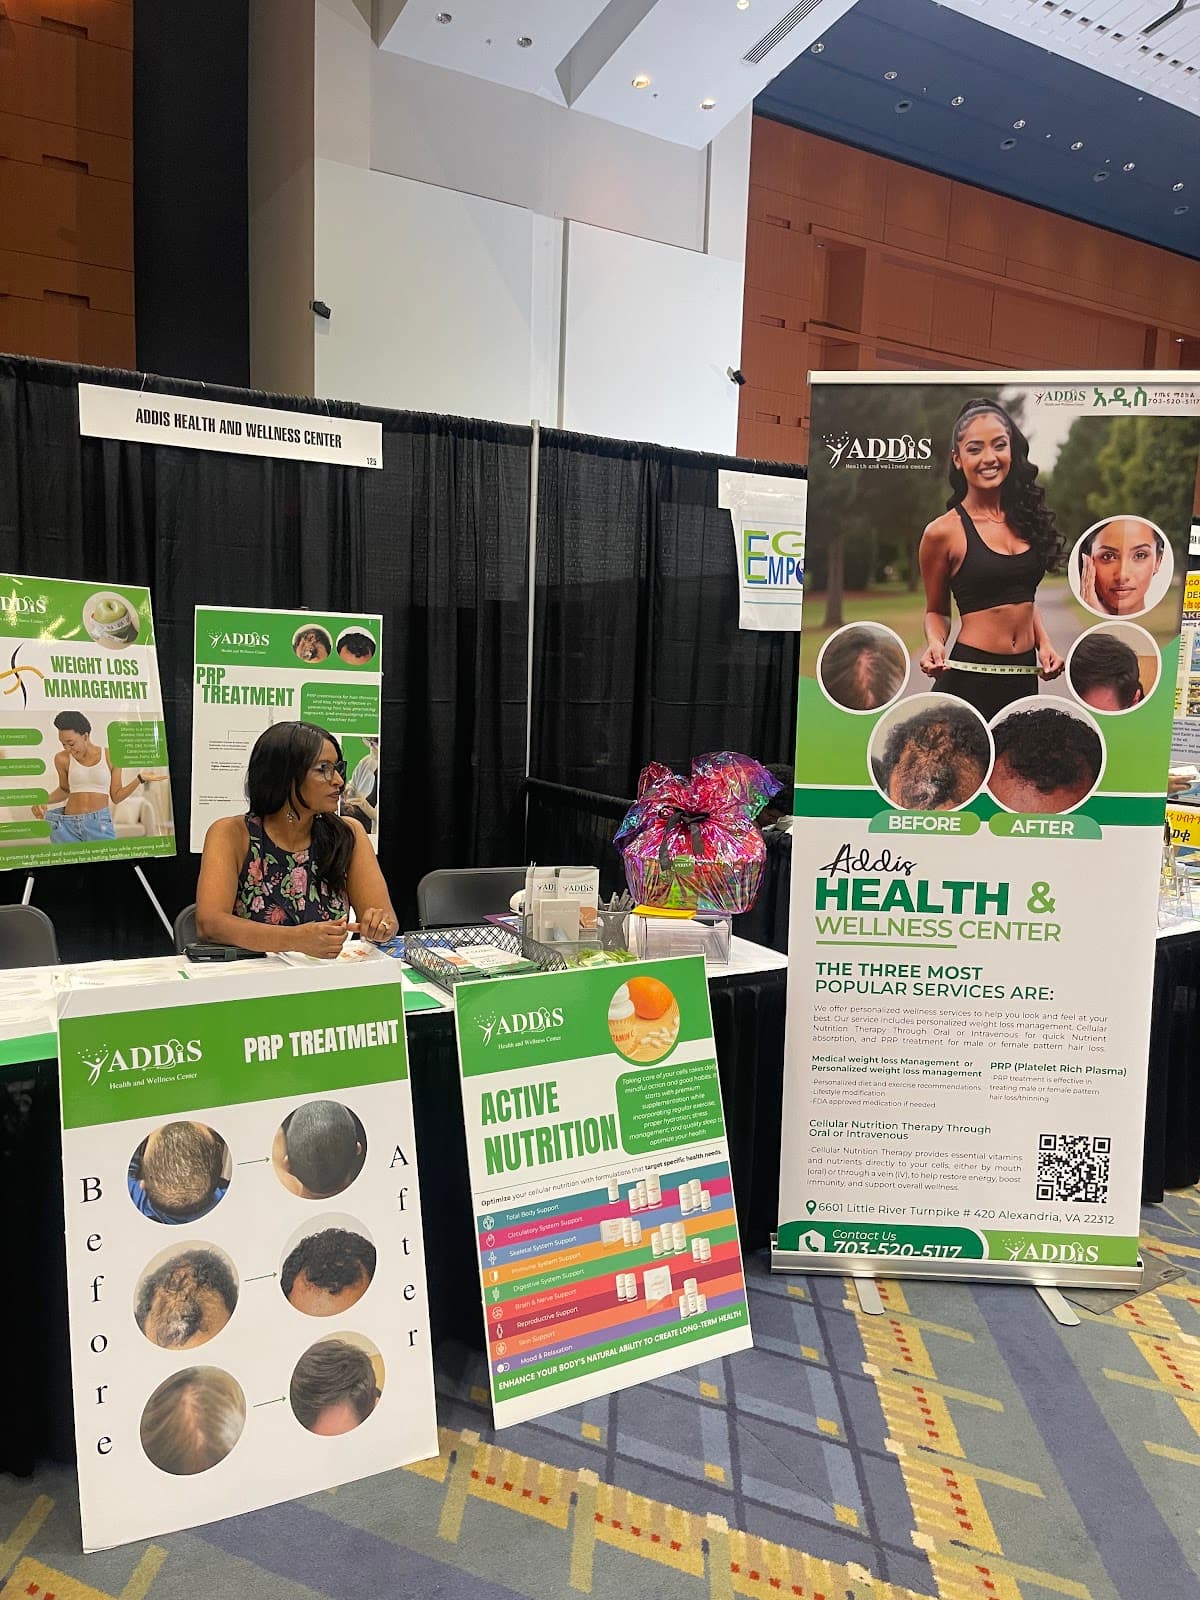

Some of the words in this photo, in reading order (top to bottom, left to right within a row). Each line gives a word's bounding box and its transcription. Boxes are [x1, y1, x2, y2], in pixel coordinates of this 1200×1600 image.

[1093, 386, 1147, 408] አዲስ
[136, 408, 169, 426] ADDIS
[174, 413, 215, 432] HEALTH
[219, 419, 241, 435] AND
[245, 422, 300, 443] WELLNESS
[304, 430, 341, 448] CENTER
[50, 656, 102, 673] WEIGHT
[106, 658, 139, 676] LOSS
[196, 667, 225, 684] PRP
[44, 679, 148, 699] MANAGEMENT
[202, 684, 294, 706] TREATMENT
[888, 816, 960, 832] BEFORE
[1010, 819, 1075, 835] AFTER
[819, 844, 917, 877] Addis
[815, 878, 1009, 916] HEALTH
[1027, 881, 1056, 914] &
[815, 916, 953, 938] WELLNESS
[959, 920, 1061, 942] CENTER
[815, 962, 852, 976] THE
[858, 963, 920, 978] THREE
[927, 965, 982, 980] MOST
[816, 979, 906, 995] POPULAR
[912, 982, 1004, 998] SERVICES
[1010, 986, 1053, 1000] ARE:
[496, 1007, 564, 1034] ADDiS
[244, 1037, 283, 1064] PRP
[289, 1019, 399, 1057] TREATMENT
[107, 1038, 202, 1071] ADDiS
[847, 1056, 878, 1064] weight
[900, 1058, 959, 1066] Management
[869, 1066, 900, 1074] weight
[922, 1069, 982, 1077] management
[1014, 1062, 1056, 1072] (Platelet
[1059, 1064, 1082, 1073] Rich
[1085, 1066, 1126, 1077] Plasma)
[109, 1080, 131, 1089] Health
[481, 1081, 560, 1126] ACTIVE
[809, 1119, 848, 1131] Cellular
[851, 1120, 898, 1129] Nutrition
[901, 1122, 943, 1133] Therapy
[948, 1124, 990, 1135] Through
[809, 1128, 829, 1136] Oral
[846, 1130, 908, 1139] Intravenous
[484, 1114, 618, 1175] NUTRITION
[481, 1195, 510, 1206] Optimize
[512, 1191, 529, 1201] your
[528, 1186, 551, 1196] cellular
[552, 1180, 581, 1191] nutrition
[580, 1176, 594, 1184] with
[595, 1169, 631, 1181] formulations
[631, 1165, 645, 1173] that
[645, 1162, 664, 1170] target
[663, 1157, 684, 1167] specific
[536, 1204, 559, 1214] Support
[818, 1202, 842, 1212] 6601
[847, 1203, 874, 1213] Little
[878, 1204, 906, 1214] River
[909, 1206, 959, 1217] Turnpike
[973, 1209, 995, 1218] 420
[998, 1210, 1061, 1222] Alexandria,
[1065, 1213, 1080, 1222] VA
[1083, 1214, 1114, 1224] 22312
[507, 1227, 538, 1238] Circulatory
[538, 1222, 559, 1231] System
[560, 1216, 583, 1226] Support
[832, 1229, 879, 1240] Contact
[882, 1231, 896, 1241] Us
[509, 1246, 531, 1256] Skeletal
[532, 1242, 553, 1251] System
[554, 1235, 576, 1245] Support
[833, 1241, 963, 1258] 703-520-5117
[513, 1280, 539, 1292] Digestive
[540, 1275, 561, 1285] System
[561, 1268, 584, 1279] Support
[516, 1313, 554, 1327] Reproductive
[555, 1306, 578, 1317] Support
[498, 1372, 535, 1390] ENHANCE
[536, 1366, 557, 1377] YOUR
[586, 1348, 617, 1363] NATURAL
[618, 1340, 642, 1353] ABILITY
[654, 1329, 678, 1342] CREATE
[679, 1317, 717, 1334] LONG-TERM
[718, 1310, 741, 1322] HEALTH
[520, 1354, 537, 1364] Mood
[543, 1345, 572, 1358] Relaxation
